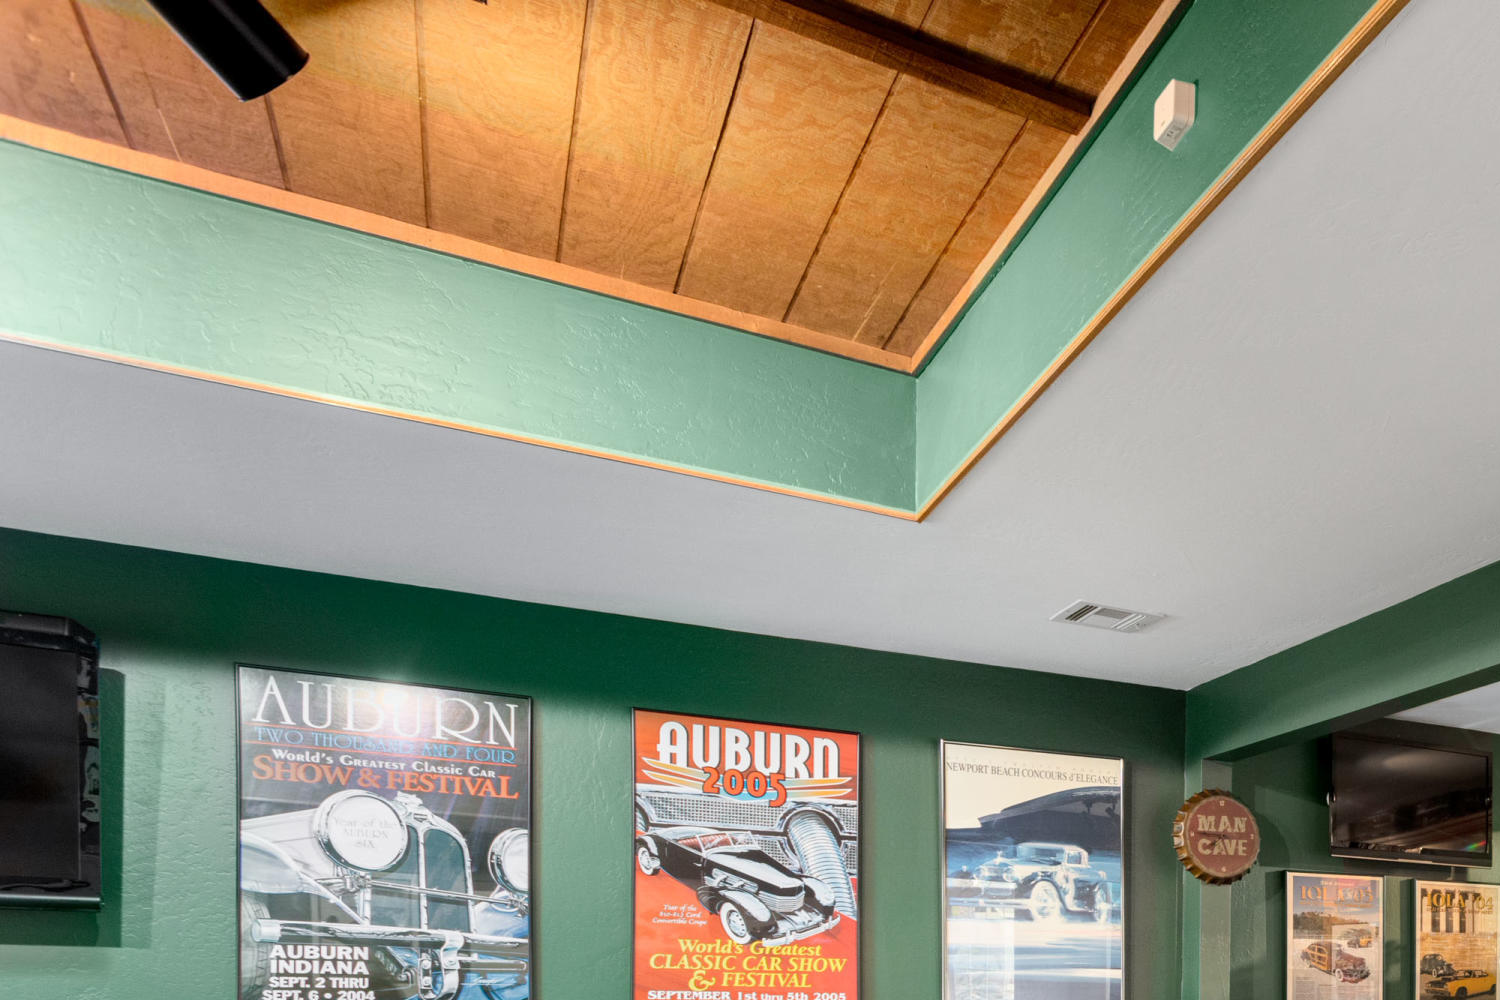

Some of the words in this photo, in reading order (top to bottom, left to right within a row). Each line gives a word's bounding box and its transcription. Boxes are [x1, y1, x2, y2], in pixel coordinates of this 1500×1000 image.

[251, 675, 518, 748] AUBURN
[254, 726, 304, 745] TWO
[311, 732, 415, 755] THOUSAND
[423, 742, 457, 759] AND
[466, 746, 517, 764] FOUR
[656, 721, 839, 779] AUBURN
[252, 754, 354, 786] SHOW
[357, 767, 382, 788] &
[386, 770, 520, 799] FESTIVAL
[946, 762, 989, 774] NEWPORT
[991, 765, 1020, 777] BEACH
[1021, 768, 1067, 781] CONCOURS
[1069, 774, 1118, 785] d'ELEGANCE
[702, 766, 788, 807] 2005
[1197, 814, 1248, 833] MAN
[1197, 838, 1248, 856] CAVE
[1426, 892, 1467, 908] IOLA
[268, 944, 370, 961] AUBURN
[678, 938, 744, 954] World's
[750, 940, 823, 956] Greatest
[269, 959, 370, 975] INDIANA
[649, 953, 737, 971] CLASSIC
[743, 955, 785, 971] CAR
[787, 957, 848, 973] SHOW
[268, 976, 311, 989] SEPT.
[314, 977, 327, 989] 2
[328, 977, 370, 989] THRU
[688, 969, 716, 991] &
[721, 971, 813, 988] FESTIVAL
[647, 990, 732, 1000] SEPTEMBER
[737, 991, 757, 1000] 1st
[760, 993, 784, 1000] thru
[787, 992, 809, 1000] 5th
